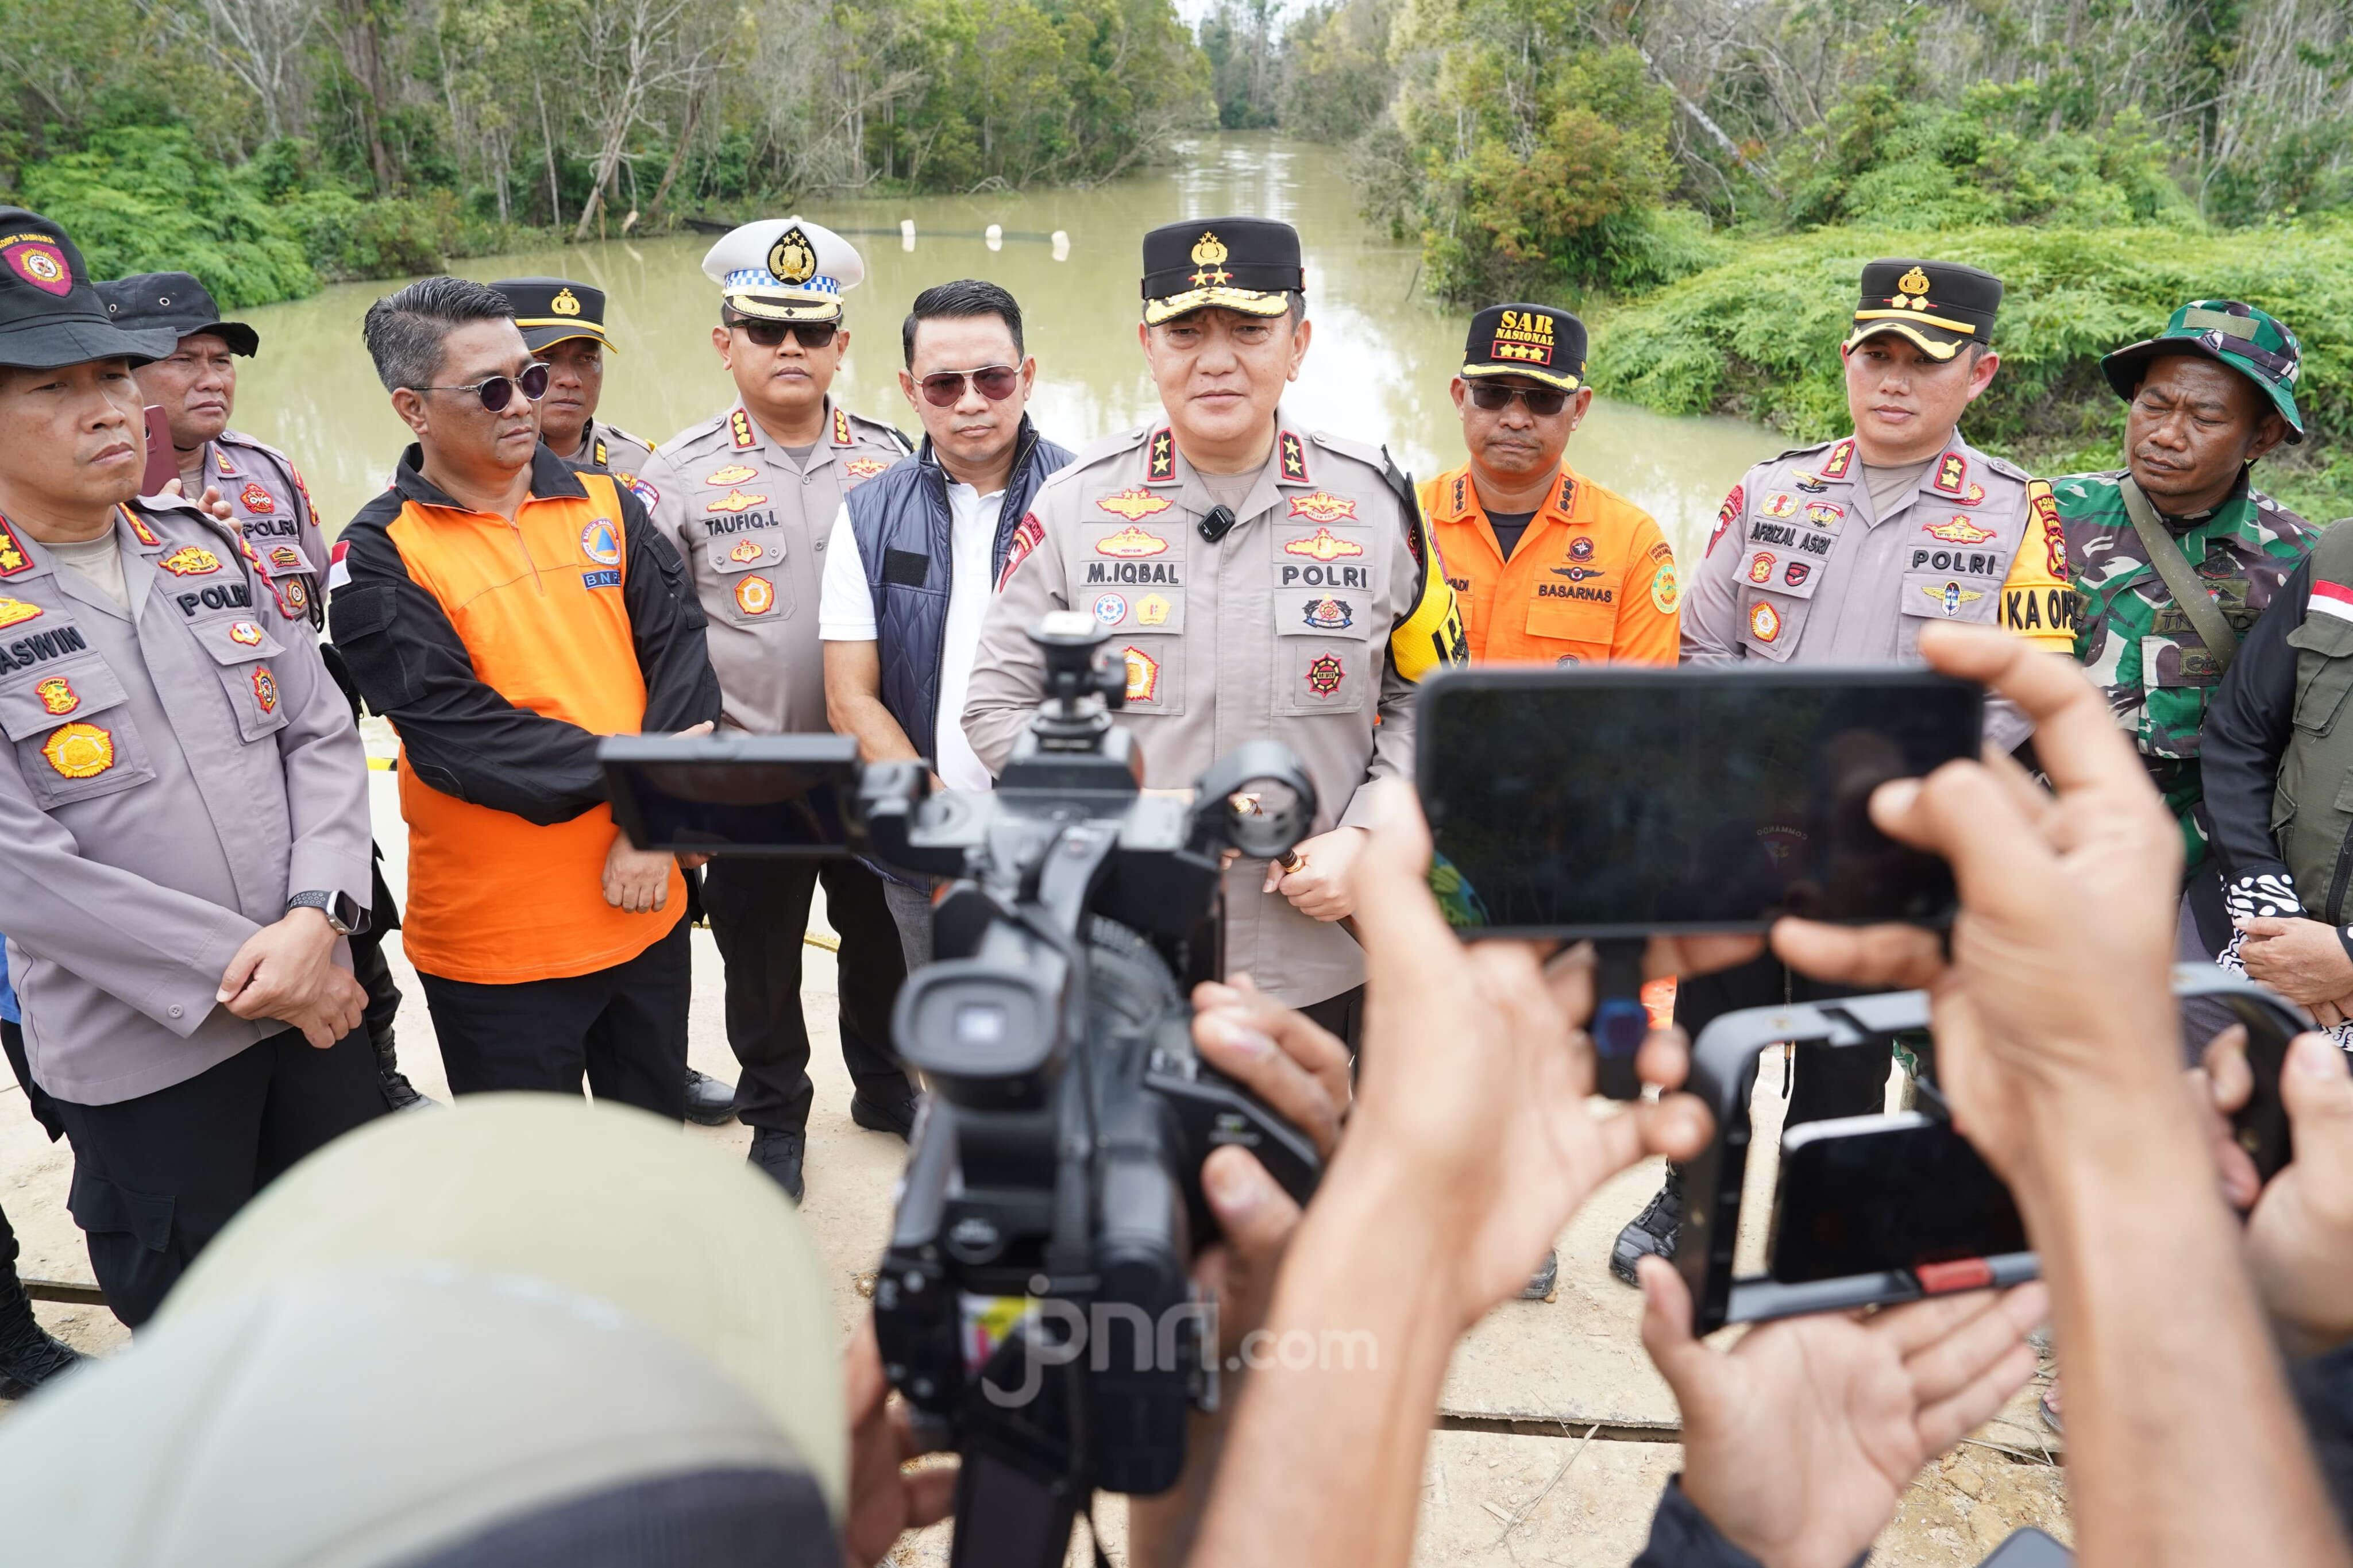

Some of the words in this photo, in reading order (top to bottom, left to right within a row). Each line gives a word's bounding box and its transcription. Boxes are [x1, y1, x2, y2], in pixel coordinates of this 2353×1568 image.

[1501, 310, 1553, 335] SAR
[1495, 328, 1554, 346] NASIONAL
[242, 519, 298, 539] POLRI
[705, 510, 778, 536] TAUFIQ.L
[1750, 522, 1796, 546] AFRIZAL
[1799, 532, 1831, 555] ASRI
[1087, 562, 1179, 584] M.IQBAL
[1912, 550, 1996, 575] POLRI
[585, 572, 620, 586] BNP
[1282, 565, 1367, 588] POLRI
[1538, 584, 1613, 603] BASARNAS
[2007, 590, 2041, 630] KA
[0, 626, 87, 675] ASWIN
